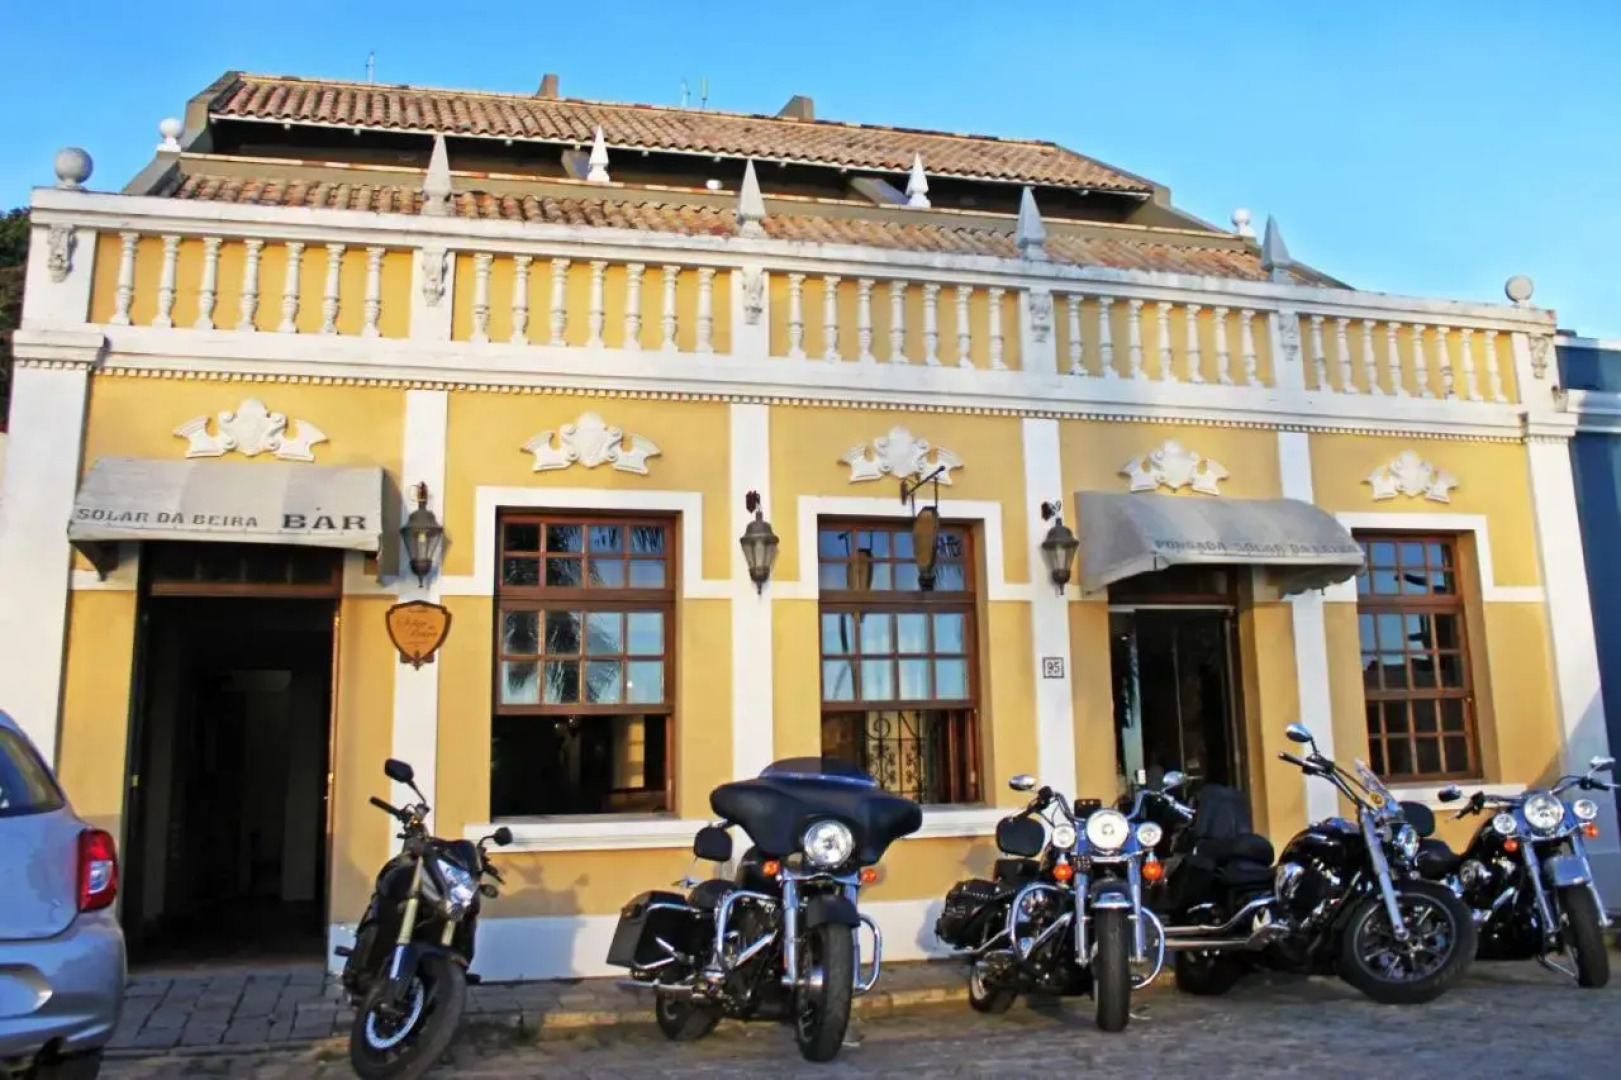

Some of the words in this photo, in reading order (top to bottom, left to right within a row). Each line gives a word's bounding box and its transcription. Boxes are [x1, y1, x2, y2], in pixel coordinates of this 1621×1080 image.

[76, 508, 149, 524] SOLAR
[157, 512, 184, 524] DA
[192, 514, 258, 528] BEIRA
[282, 513, 367, 530] BAR
[1047, 661, 1061, 674] 95
